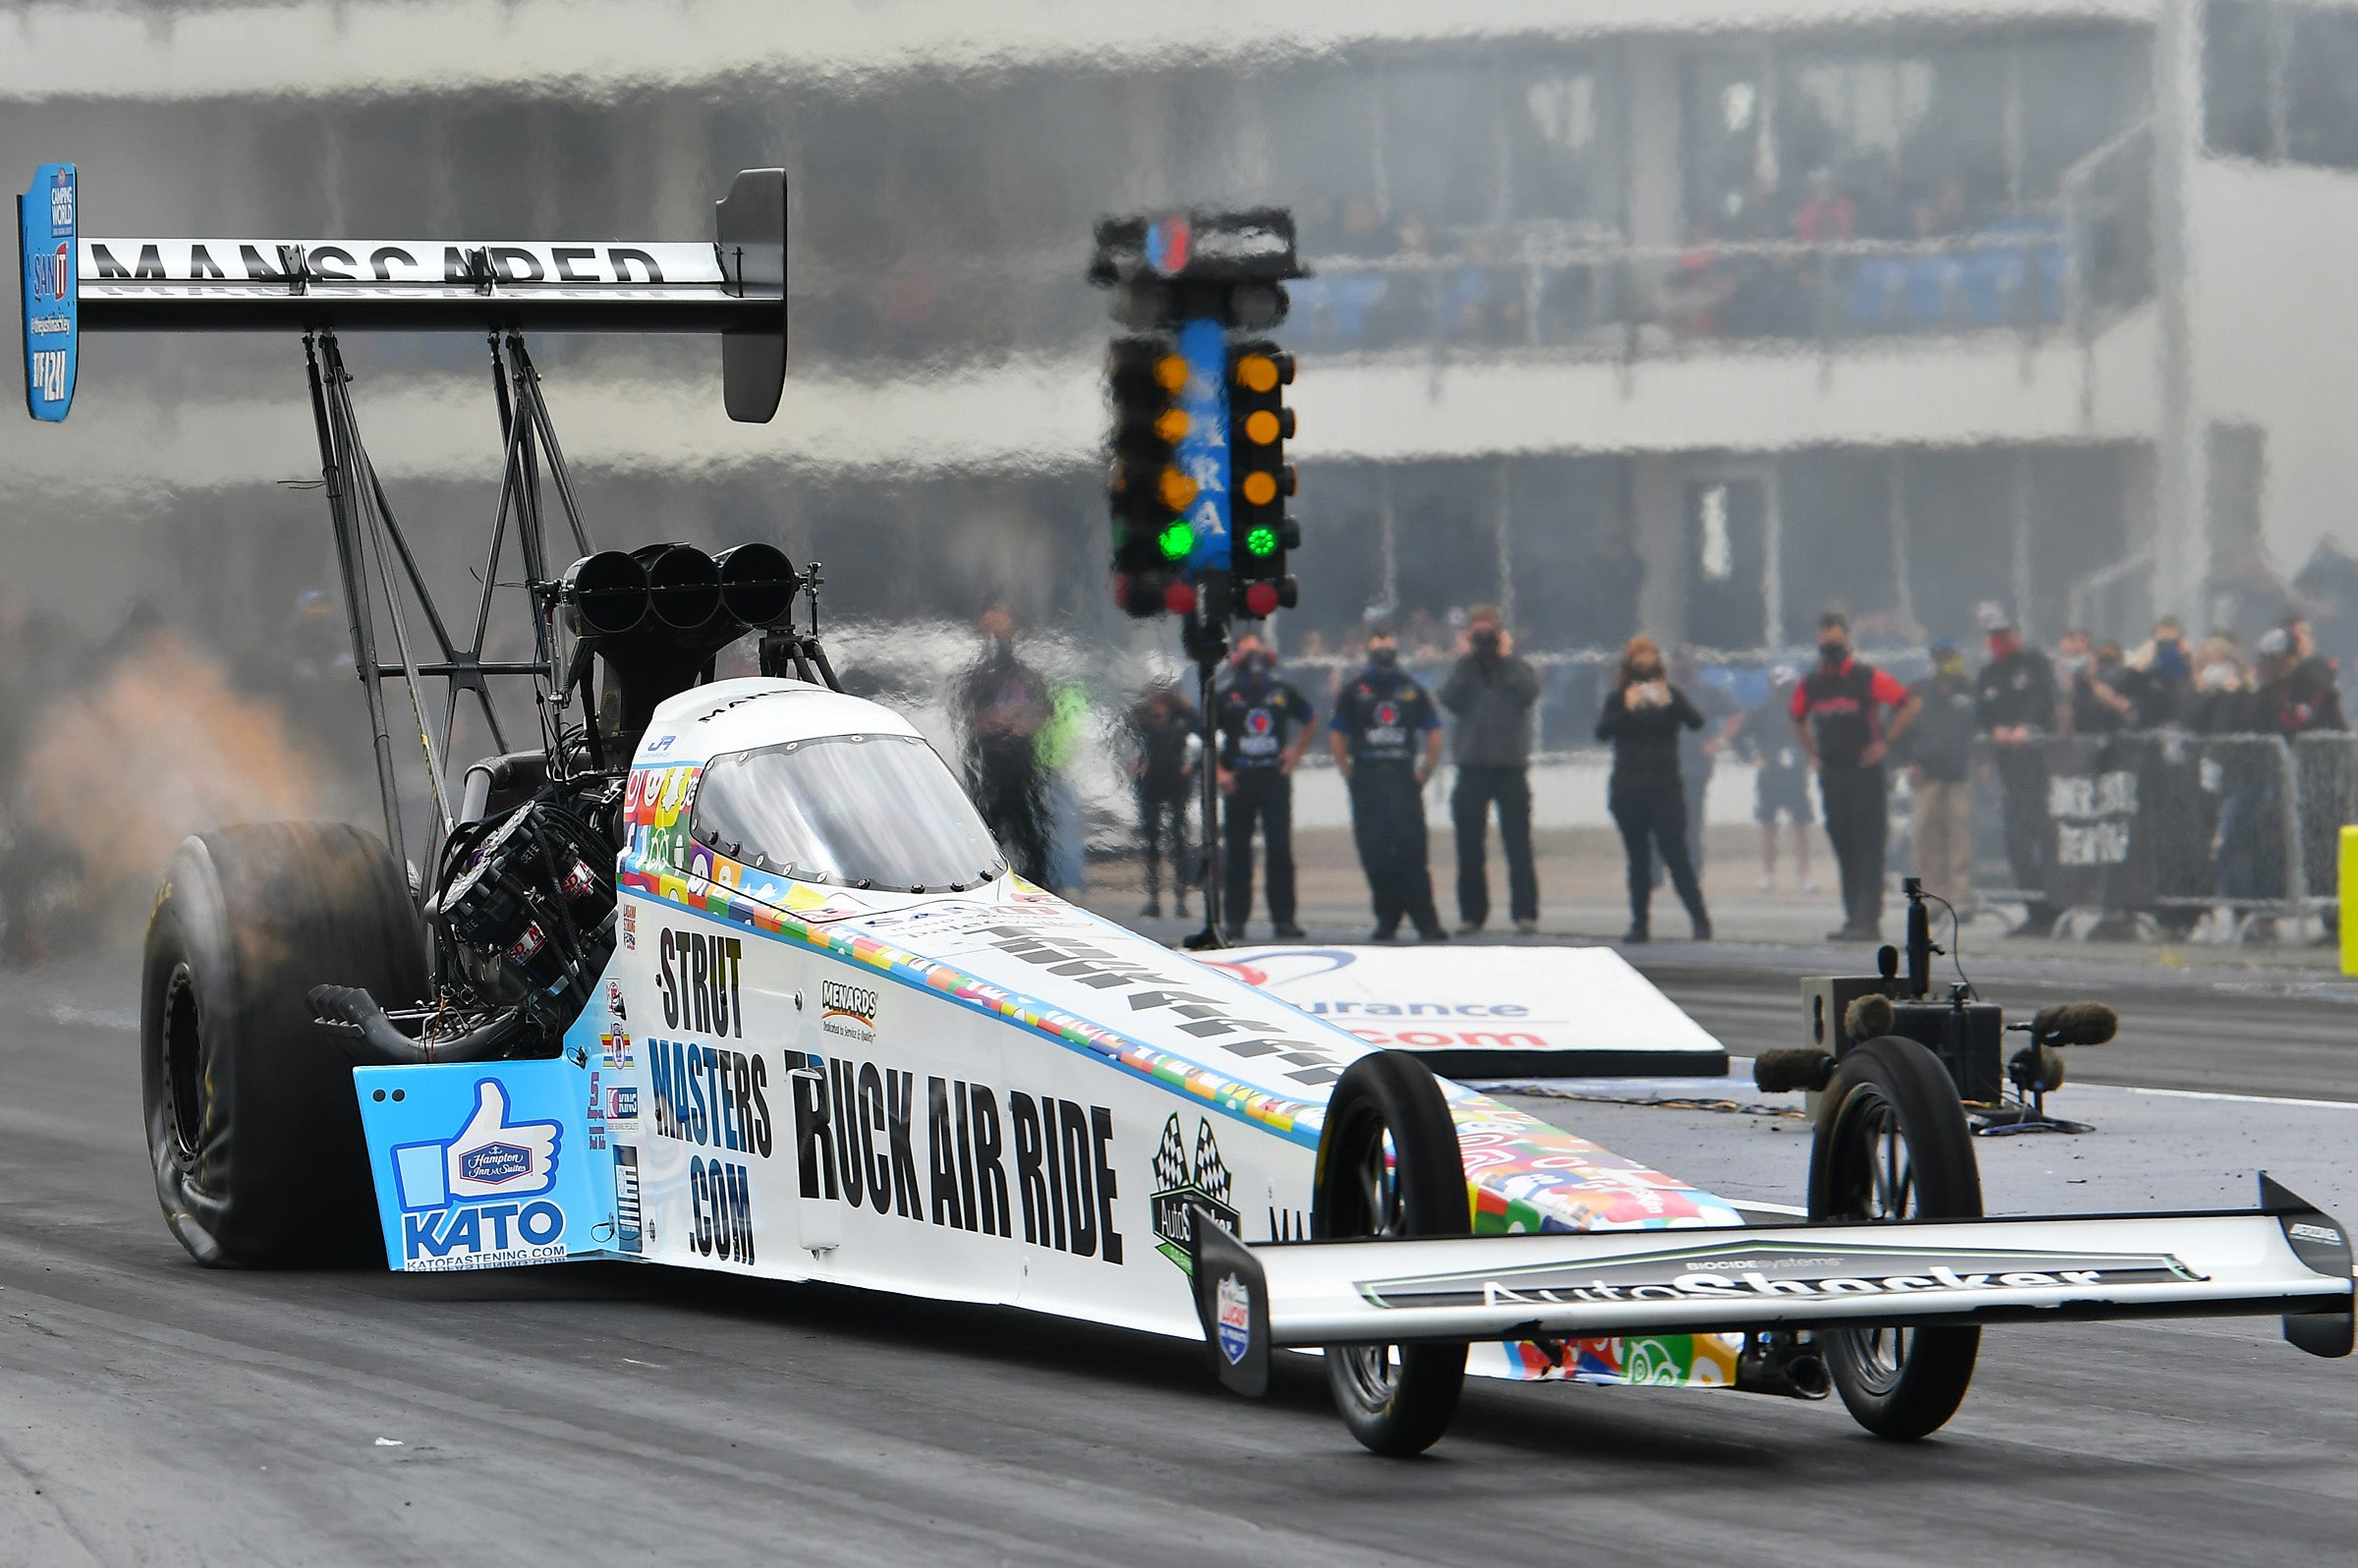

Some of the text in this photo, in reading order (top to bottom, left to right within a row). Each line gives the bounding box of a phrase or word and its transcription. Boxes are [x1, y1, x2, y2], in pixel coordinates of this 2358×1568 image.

[51, 204, 73, 226] WORLD
[659, 926, 743, 1039] STRUT
[822, 980, 876, 1020] MENARDS
[1297, 1000, 1529, 1018] urance
[618, 1092, 638, 1114] KING
[648, 1037, 773, 1159] MASTERS
[468, 1152, 524, 1169] Hampton
[468, 1163, 527, 1178] Inn & Suites
[927, 1075, 1013, 1240] AIR
[1009, 1091, 1124, 1266] RIDE
[690, 1154, 756, 1266] .COM
[404, 1201, 564, 1260] KATO
[407, 1245, 565, 1270] KATOFASTENING.COM
[1685, 1260, 1759, 1271] BIOCIDE
[1484, 1265, 2103, 1307] AutoShocker
